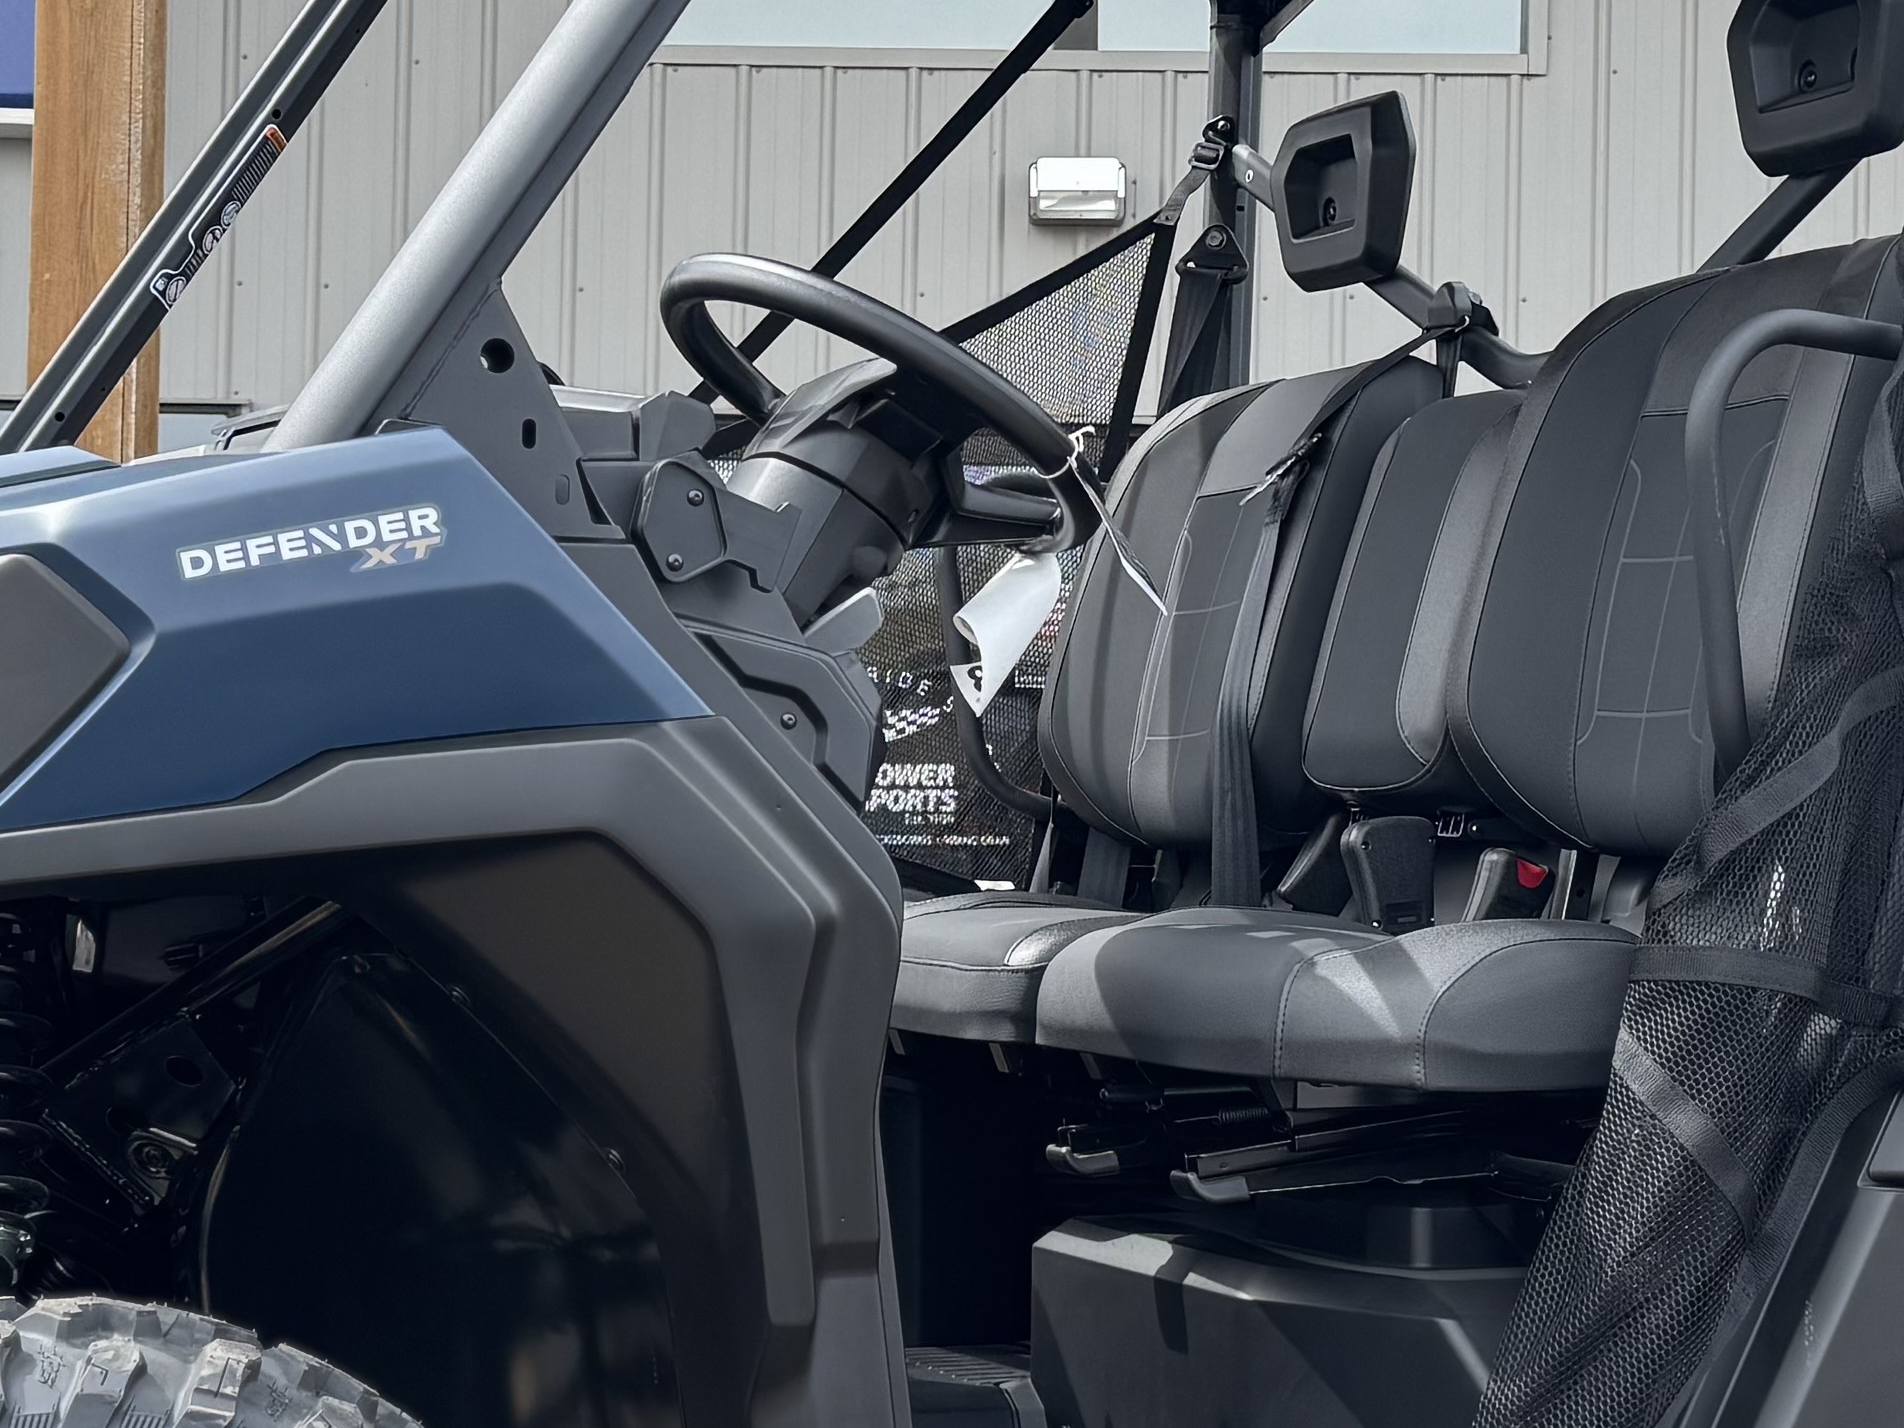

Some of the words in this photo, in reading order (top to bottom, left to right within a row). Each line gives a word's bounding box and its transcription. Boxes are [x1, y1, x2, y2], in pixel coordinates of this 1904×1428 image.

[179, 506, 441, 580] DEFENDER
[359, 535, 441, 570] XT
[874, 763, 956, 787] OWER
[865, 788, 959, 812] PORTS
